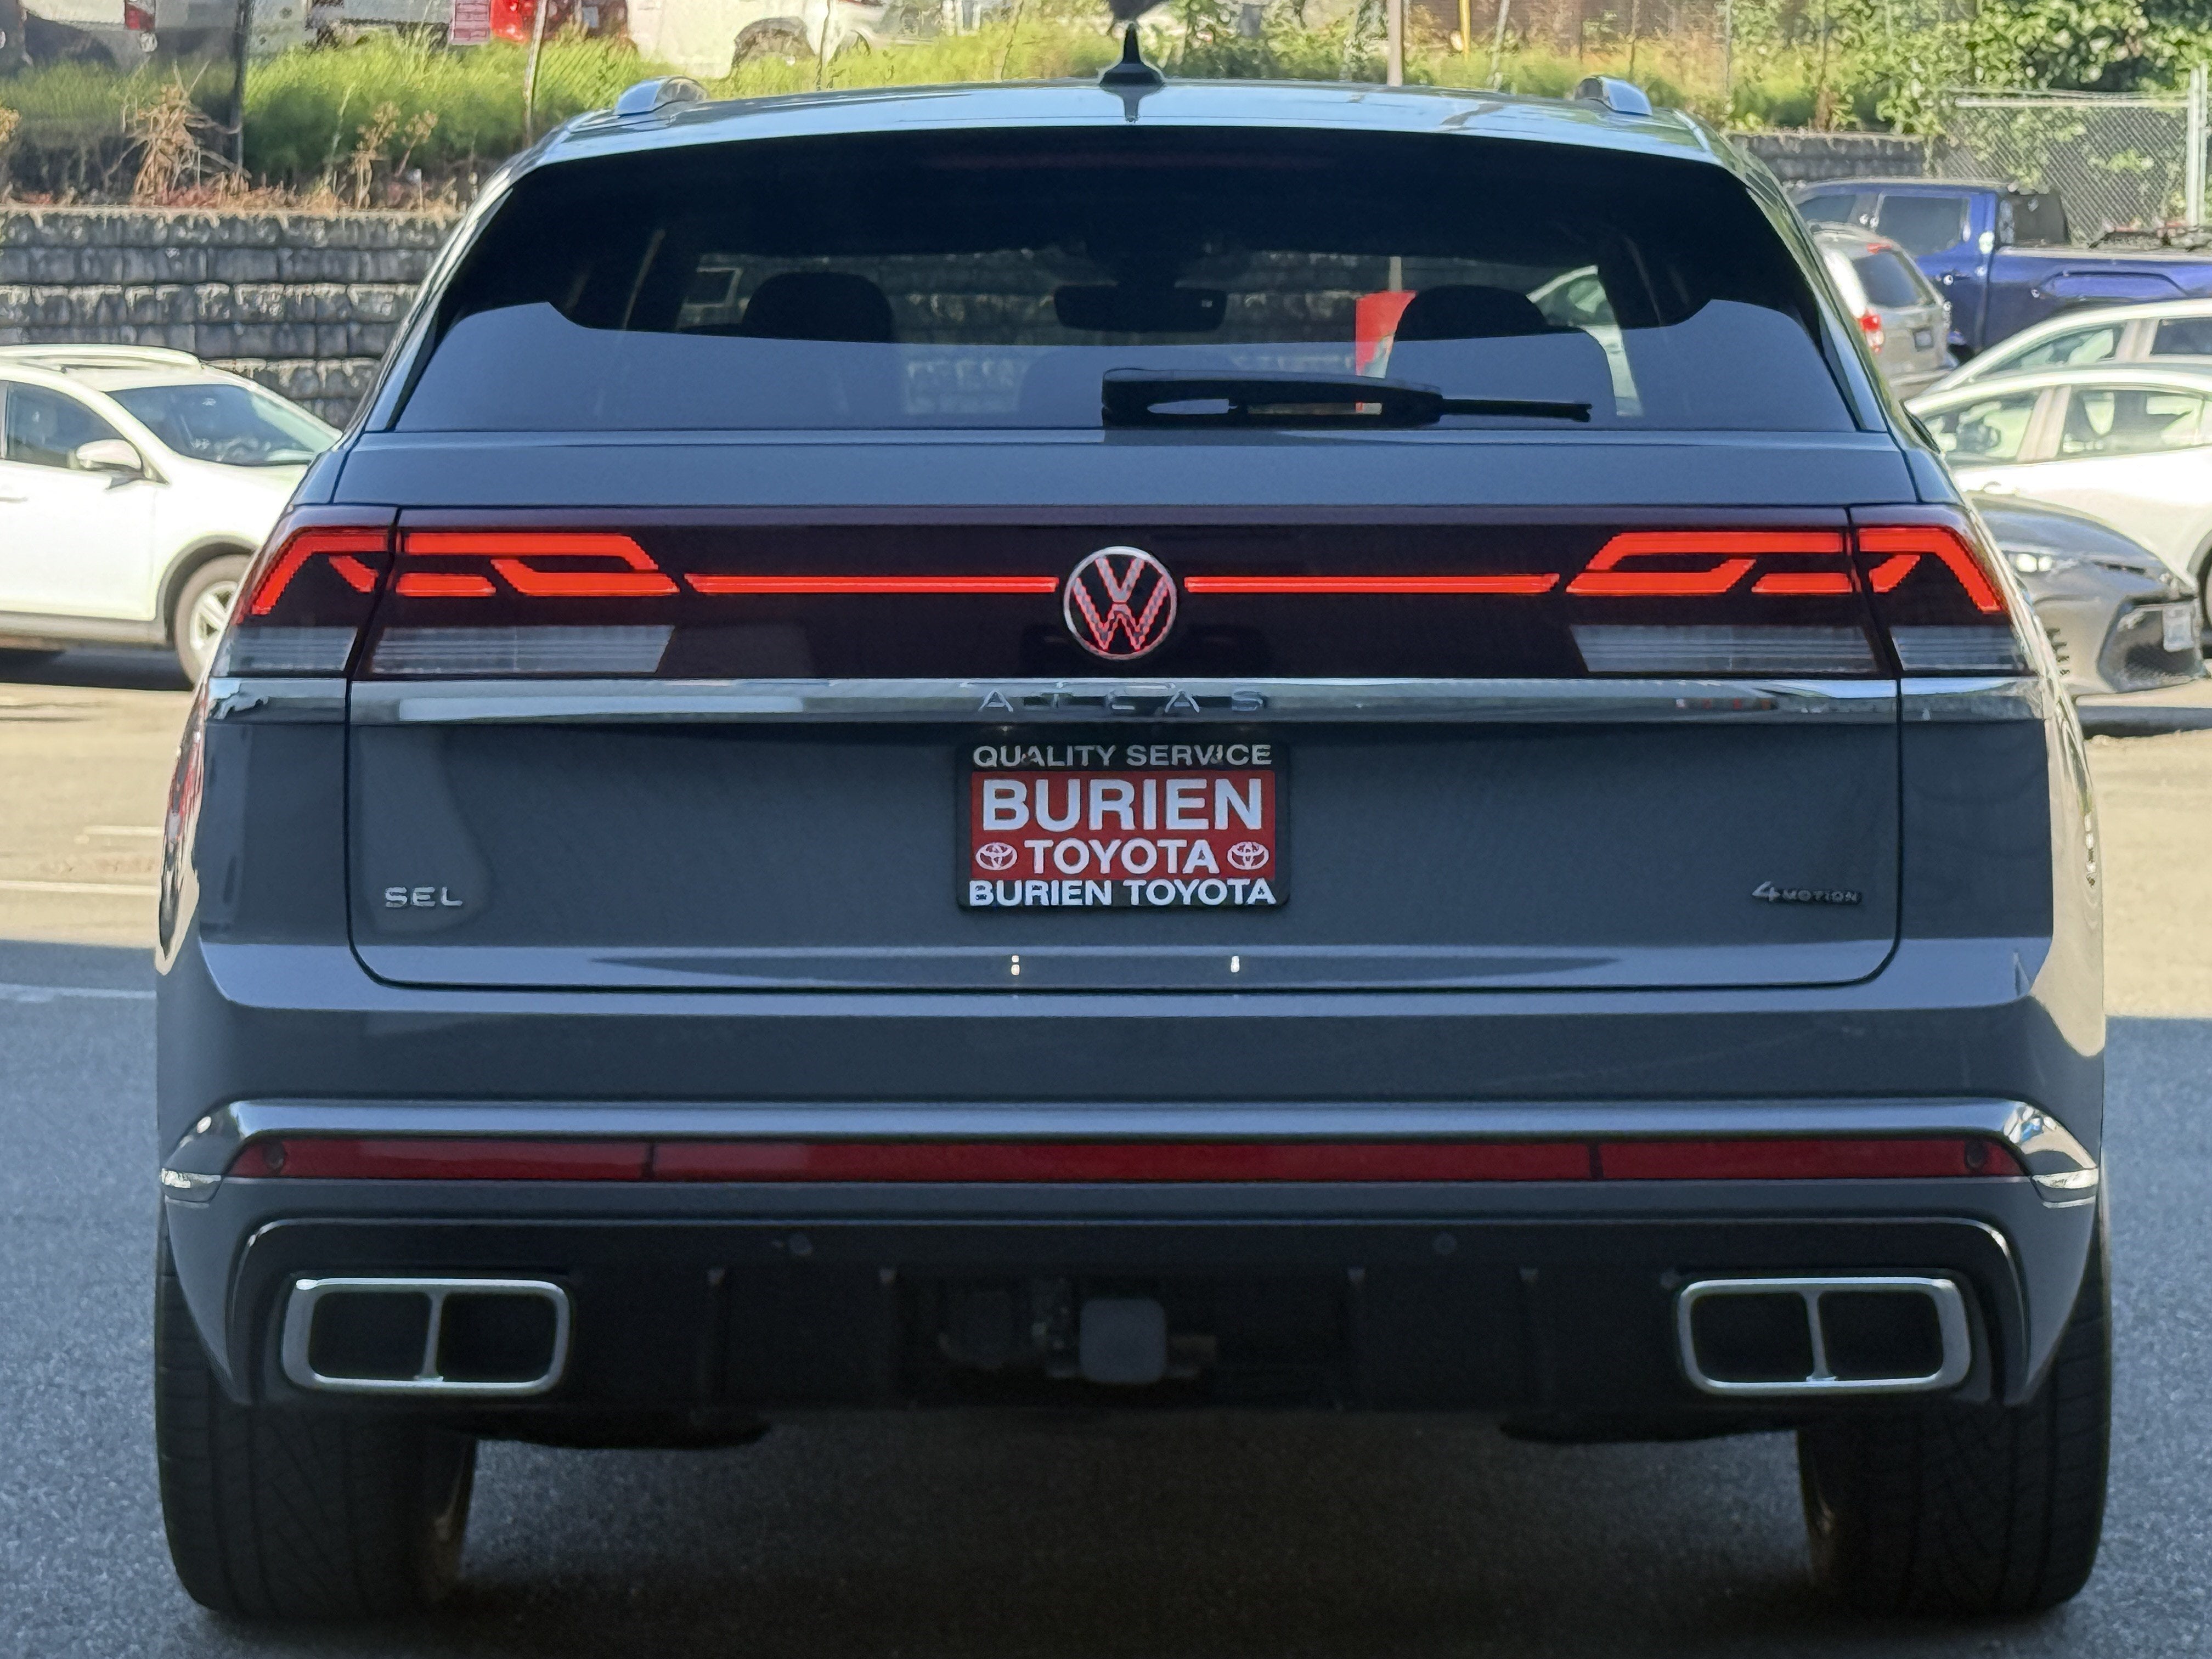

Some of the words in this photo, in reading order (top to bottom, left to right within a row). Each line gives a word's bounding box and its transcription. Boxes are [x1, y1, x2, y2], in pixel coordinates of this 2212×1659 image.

[978, 689, 1265, 713] ATLAS
[973, 744, 1117, 767] QUALITY
[1127, 744, 1272, 766] SERVICE
[983, 778, 1262, 831] BURIEN
[1024, 838, 1220, 874] TOYOTA
[385, 886, 464, 908] SEL
[969, 880, 1112, 906] BURIEN
[1122, 878, 1277, 906] TOYOTA
